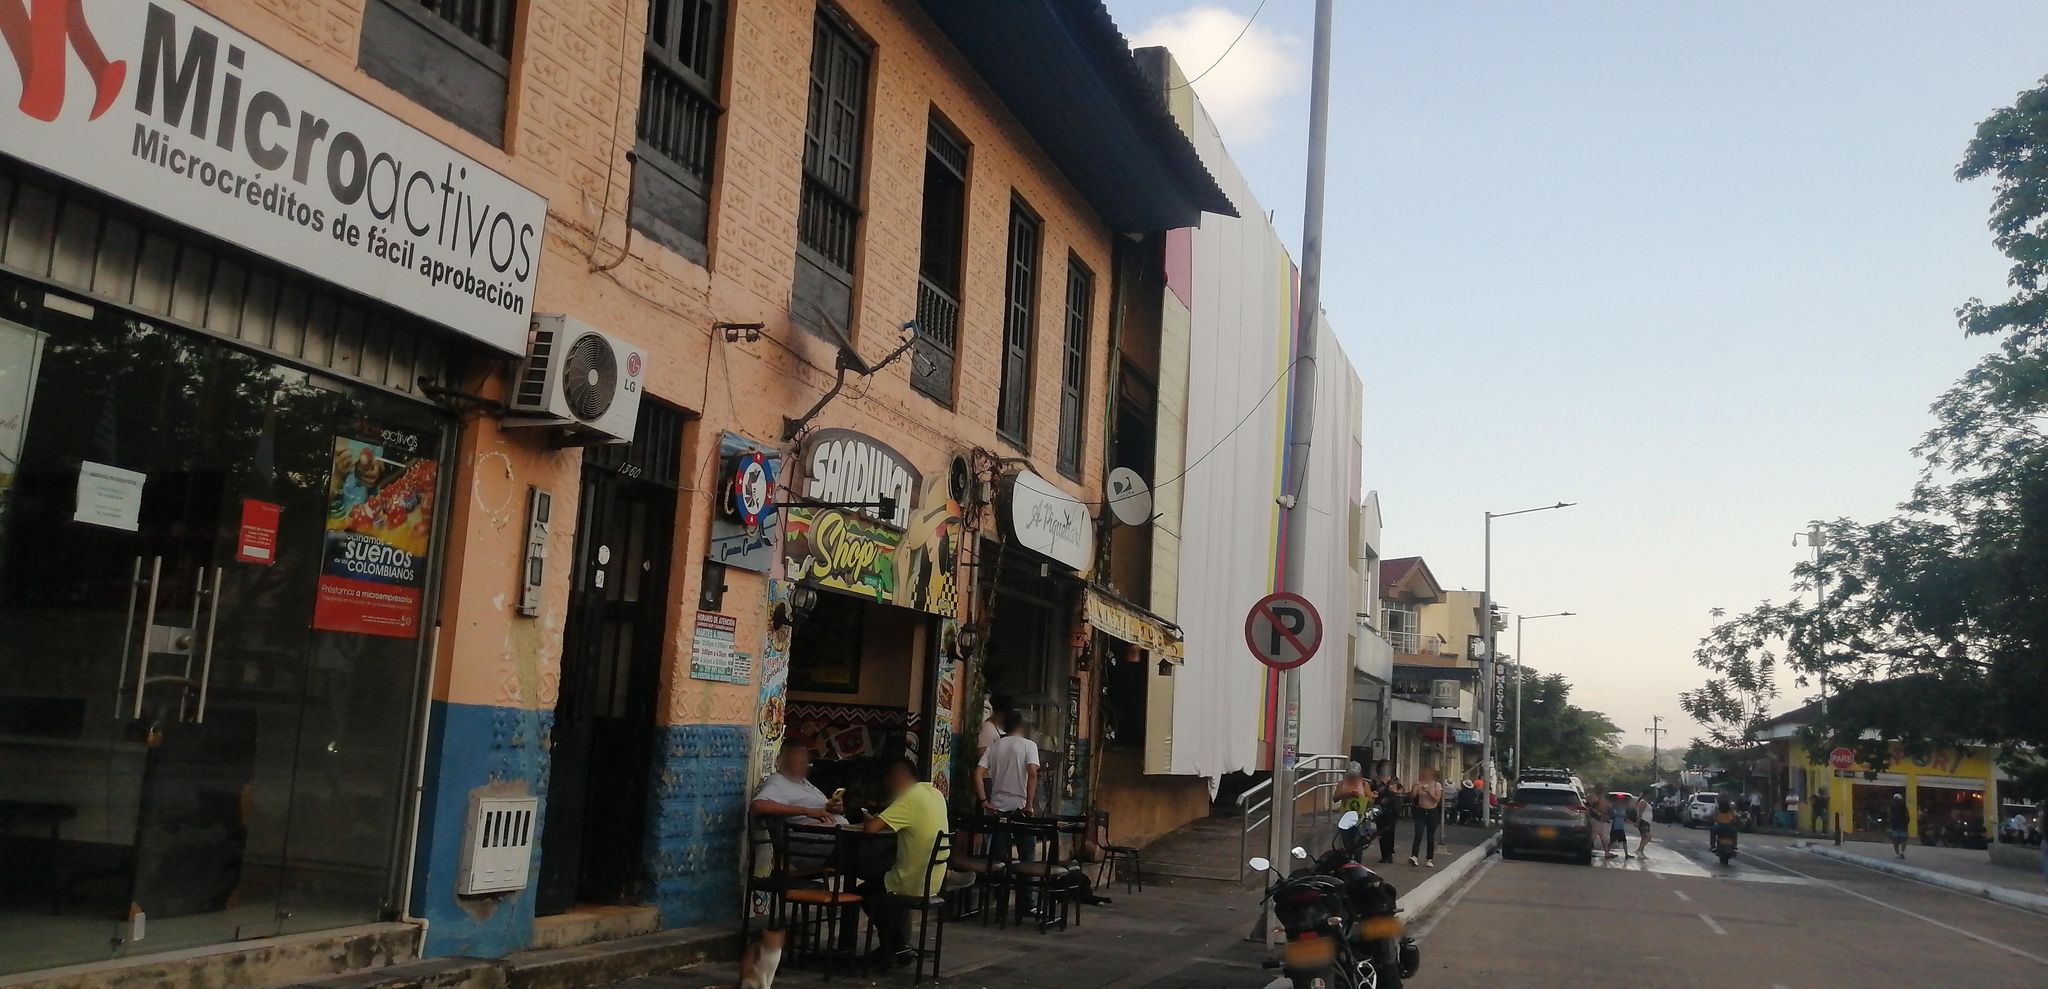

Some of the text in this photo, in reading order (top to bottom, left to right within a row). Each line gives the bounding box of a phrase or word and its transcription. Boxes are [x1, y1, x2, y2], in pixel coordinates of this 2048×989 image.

[135, 2, 535, 283] Microactivos
[132, 124, 524, 315] Microcréditos de fácil aprobación
[624, 378, 636, 393] LG
[810, 440, 913, 530] SANDWICH
[347, 560, 414, 581] COLOMBIANOS
[814, 512, 879, 582] Shop
[1270, 607, 1305, 655] P
[1832, 754, 1853, 763] PARE
